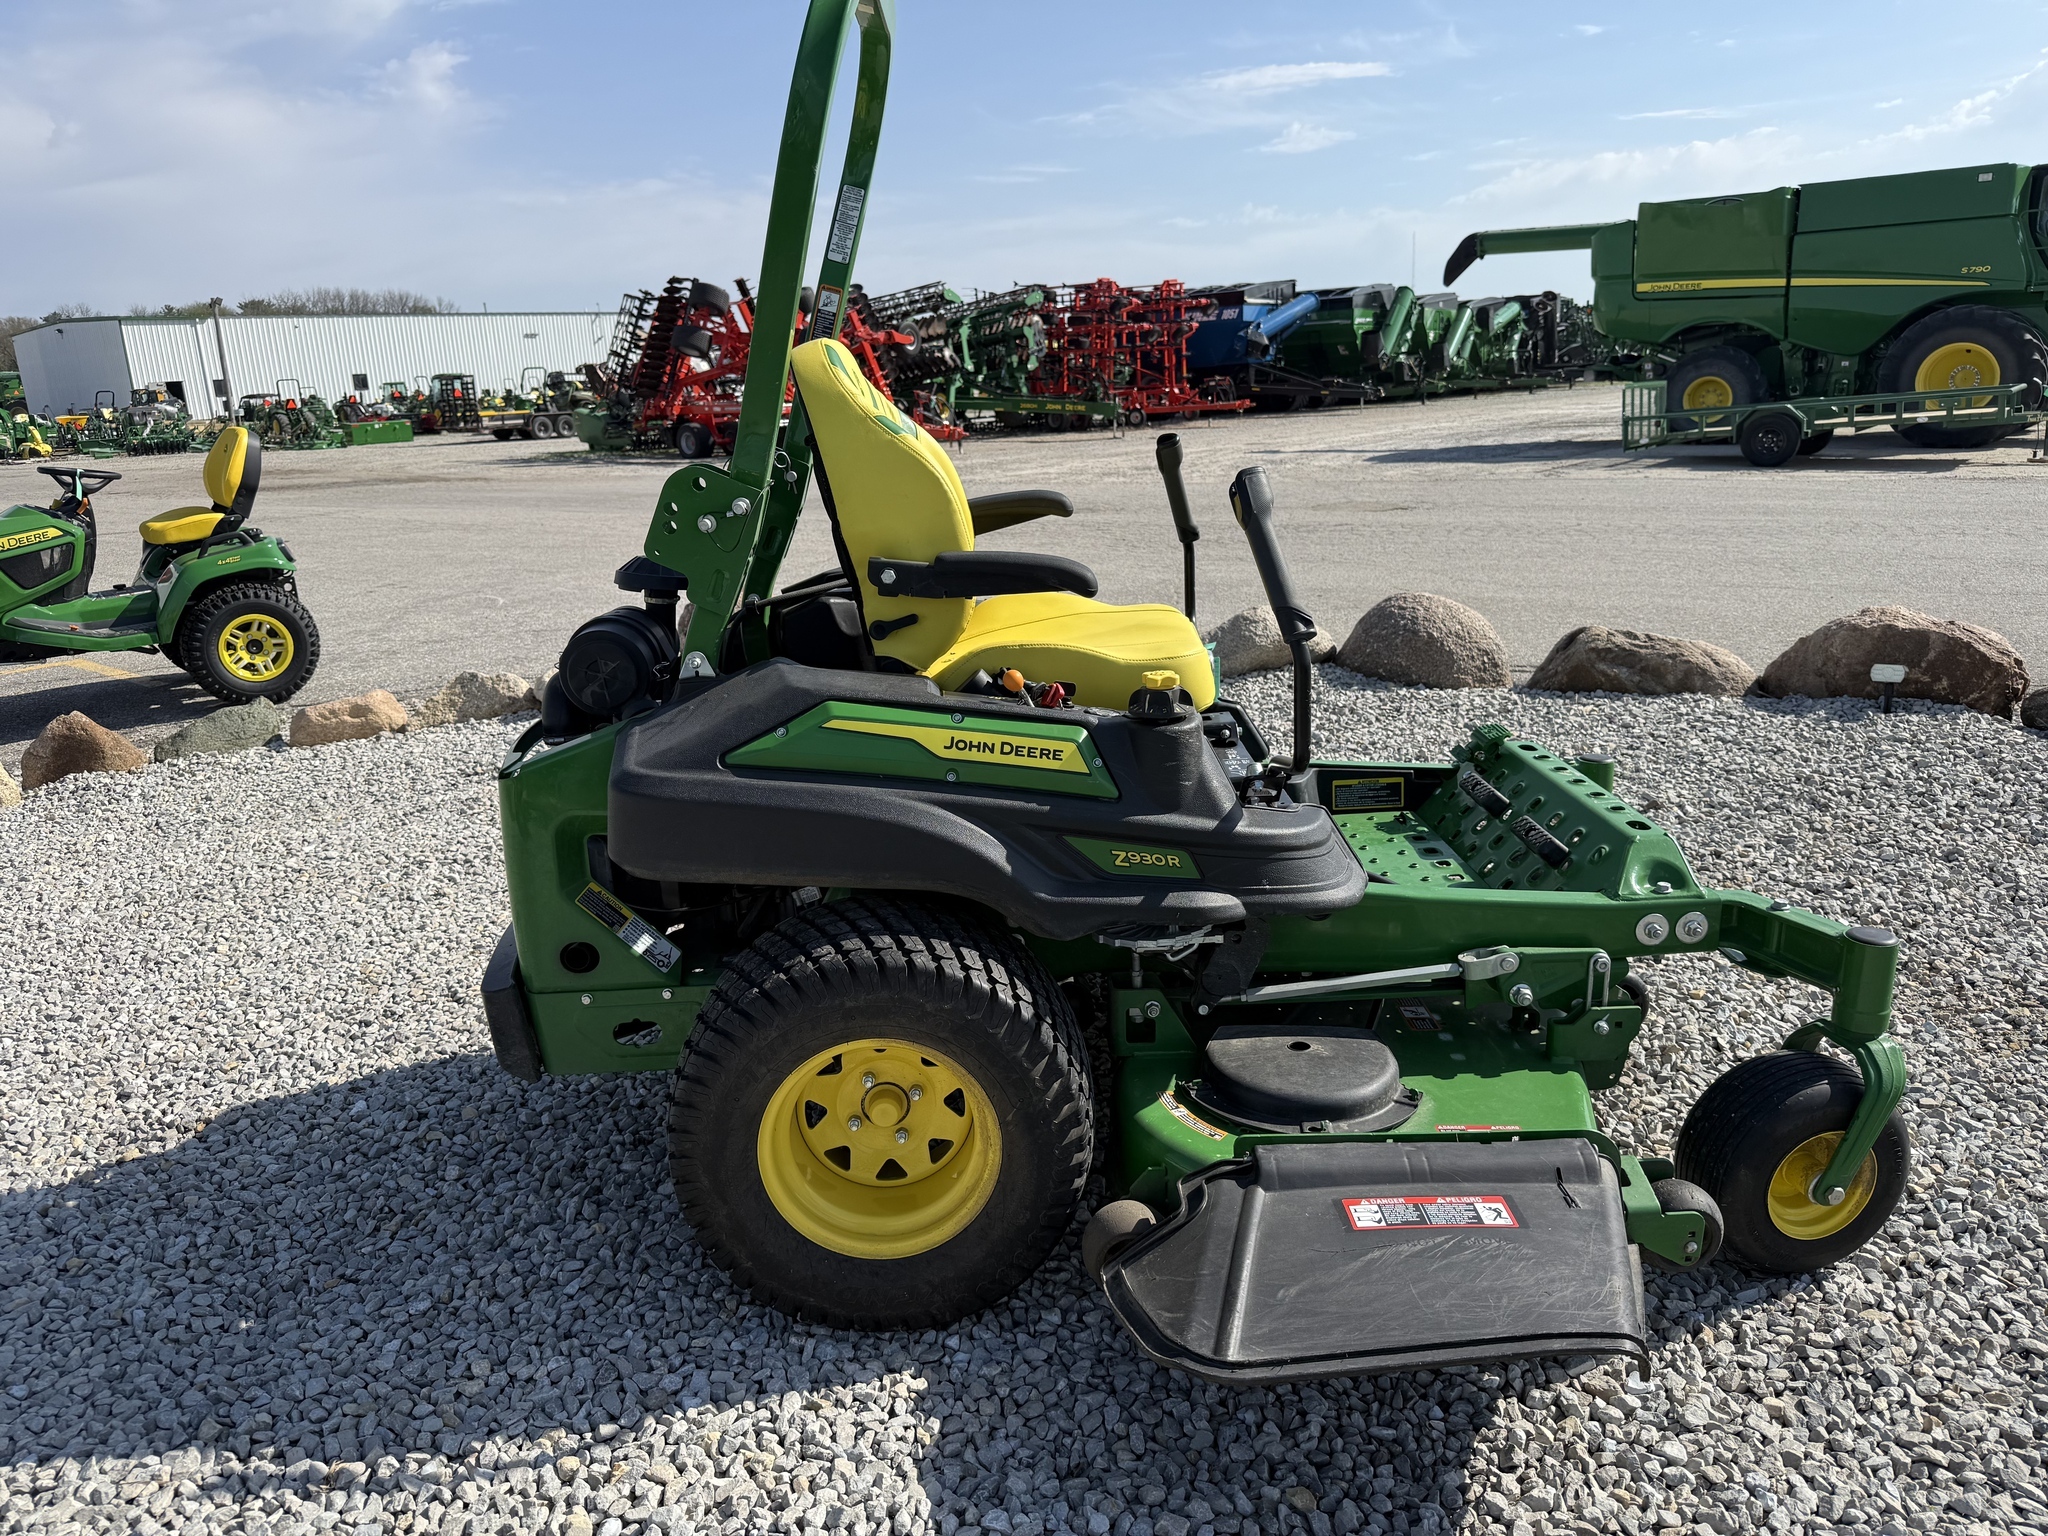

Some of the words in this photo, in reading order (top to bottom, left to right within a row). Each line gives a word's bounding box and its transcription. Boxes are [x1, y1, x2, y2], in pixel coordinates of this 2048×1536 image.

[1648, 284, 1671, 292] JOHN
[1673, 282, 1702, 290] DEERE
[1045, 402, 1062, 410] JOHN
[1065, 403, 1087, 411] DEERE
[7, 530, 51, 548] DEERE
[943, 736, 996, 754] JOHN
[999, 741, 1064, 762] DEERE
[601, 891, 625, 912] CAUTION
[1370, 1197, 1406, 1205] DANGER
[1445, 1196, 1483, 1204] PELIGRO
